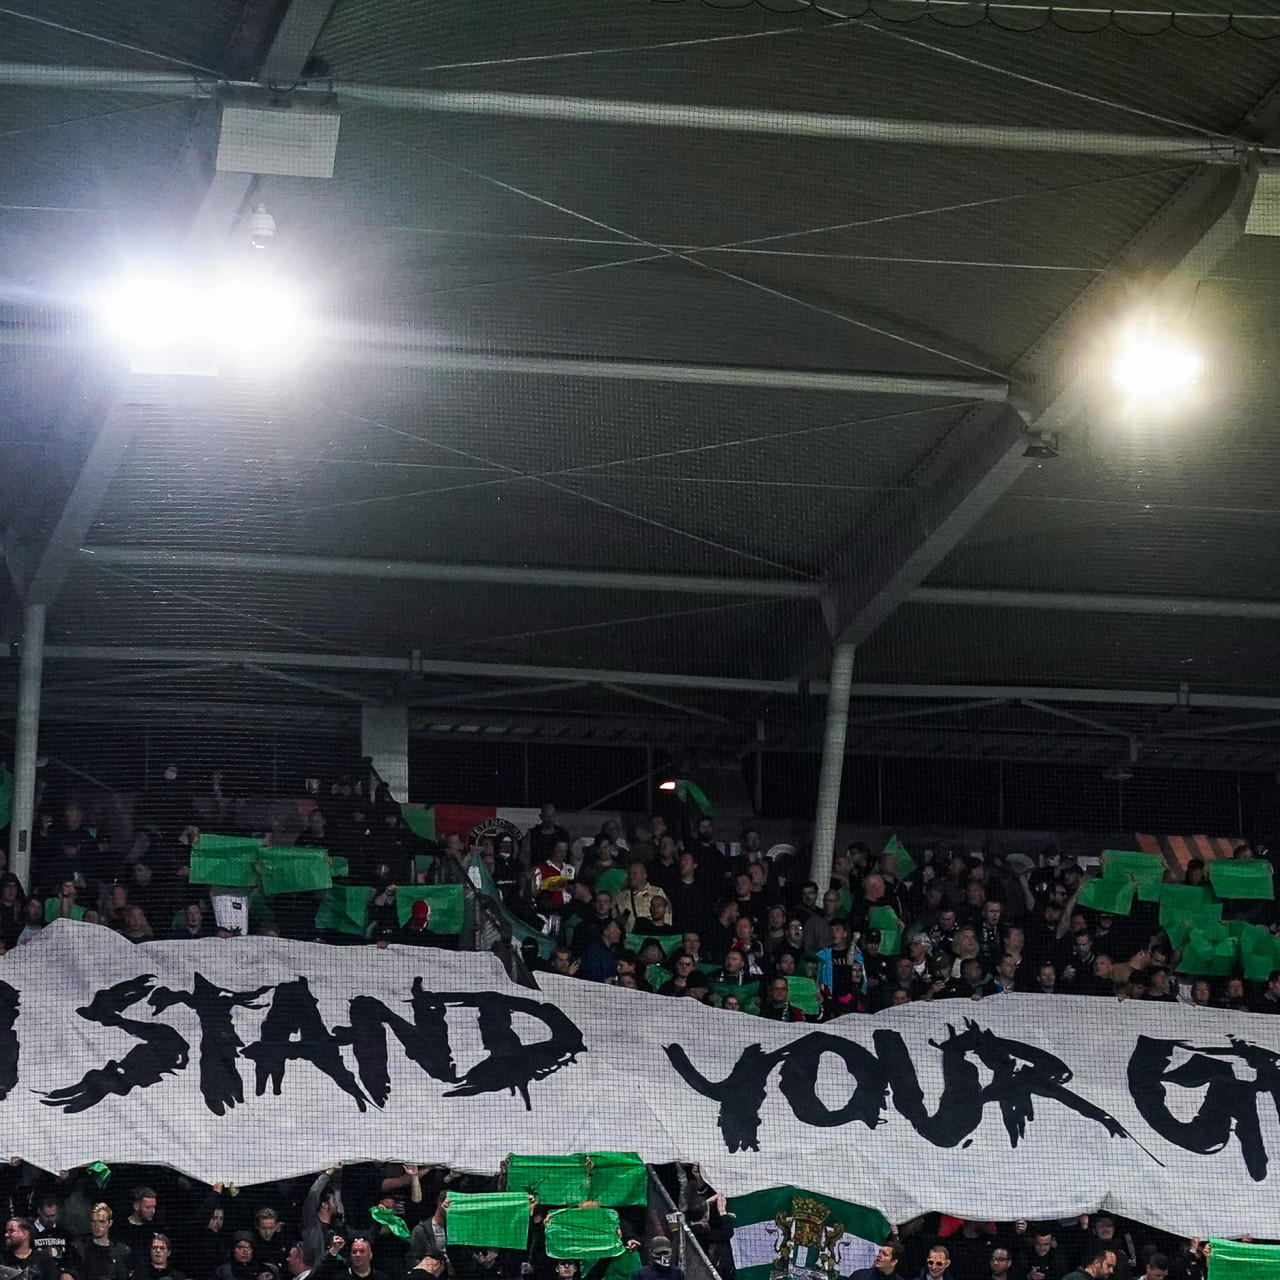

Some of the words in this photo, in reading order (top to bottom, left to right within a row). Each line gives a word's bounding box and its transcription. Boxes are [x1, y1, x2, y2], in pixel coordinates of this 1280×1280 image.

[31, 971, 589, 1117] STAND
[662, 1017, 1166, 1167] YOUR
[34, 1238, 66, 1246] ROTTERDAM
